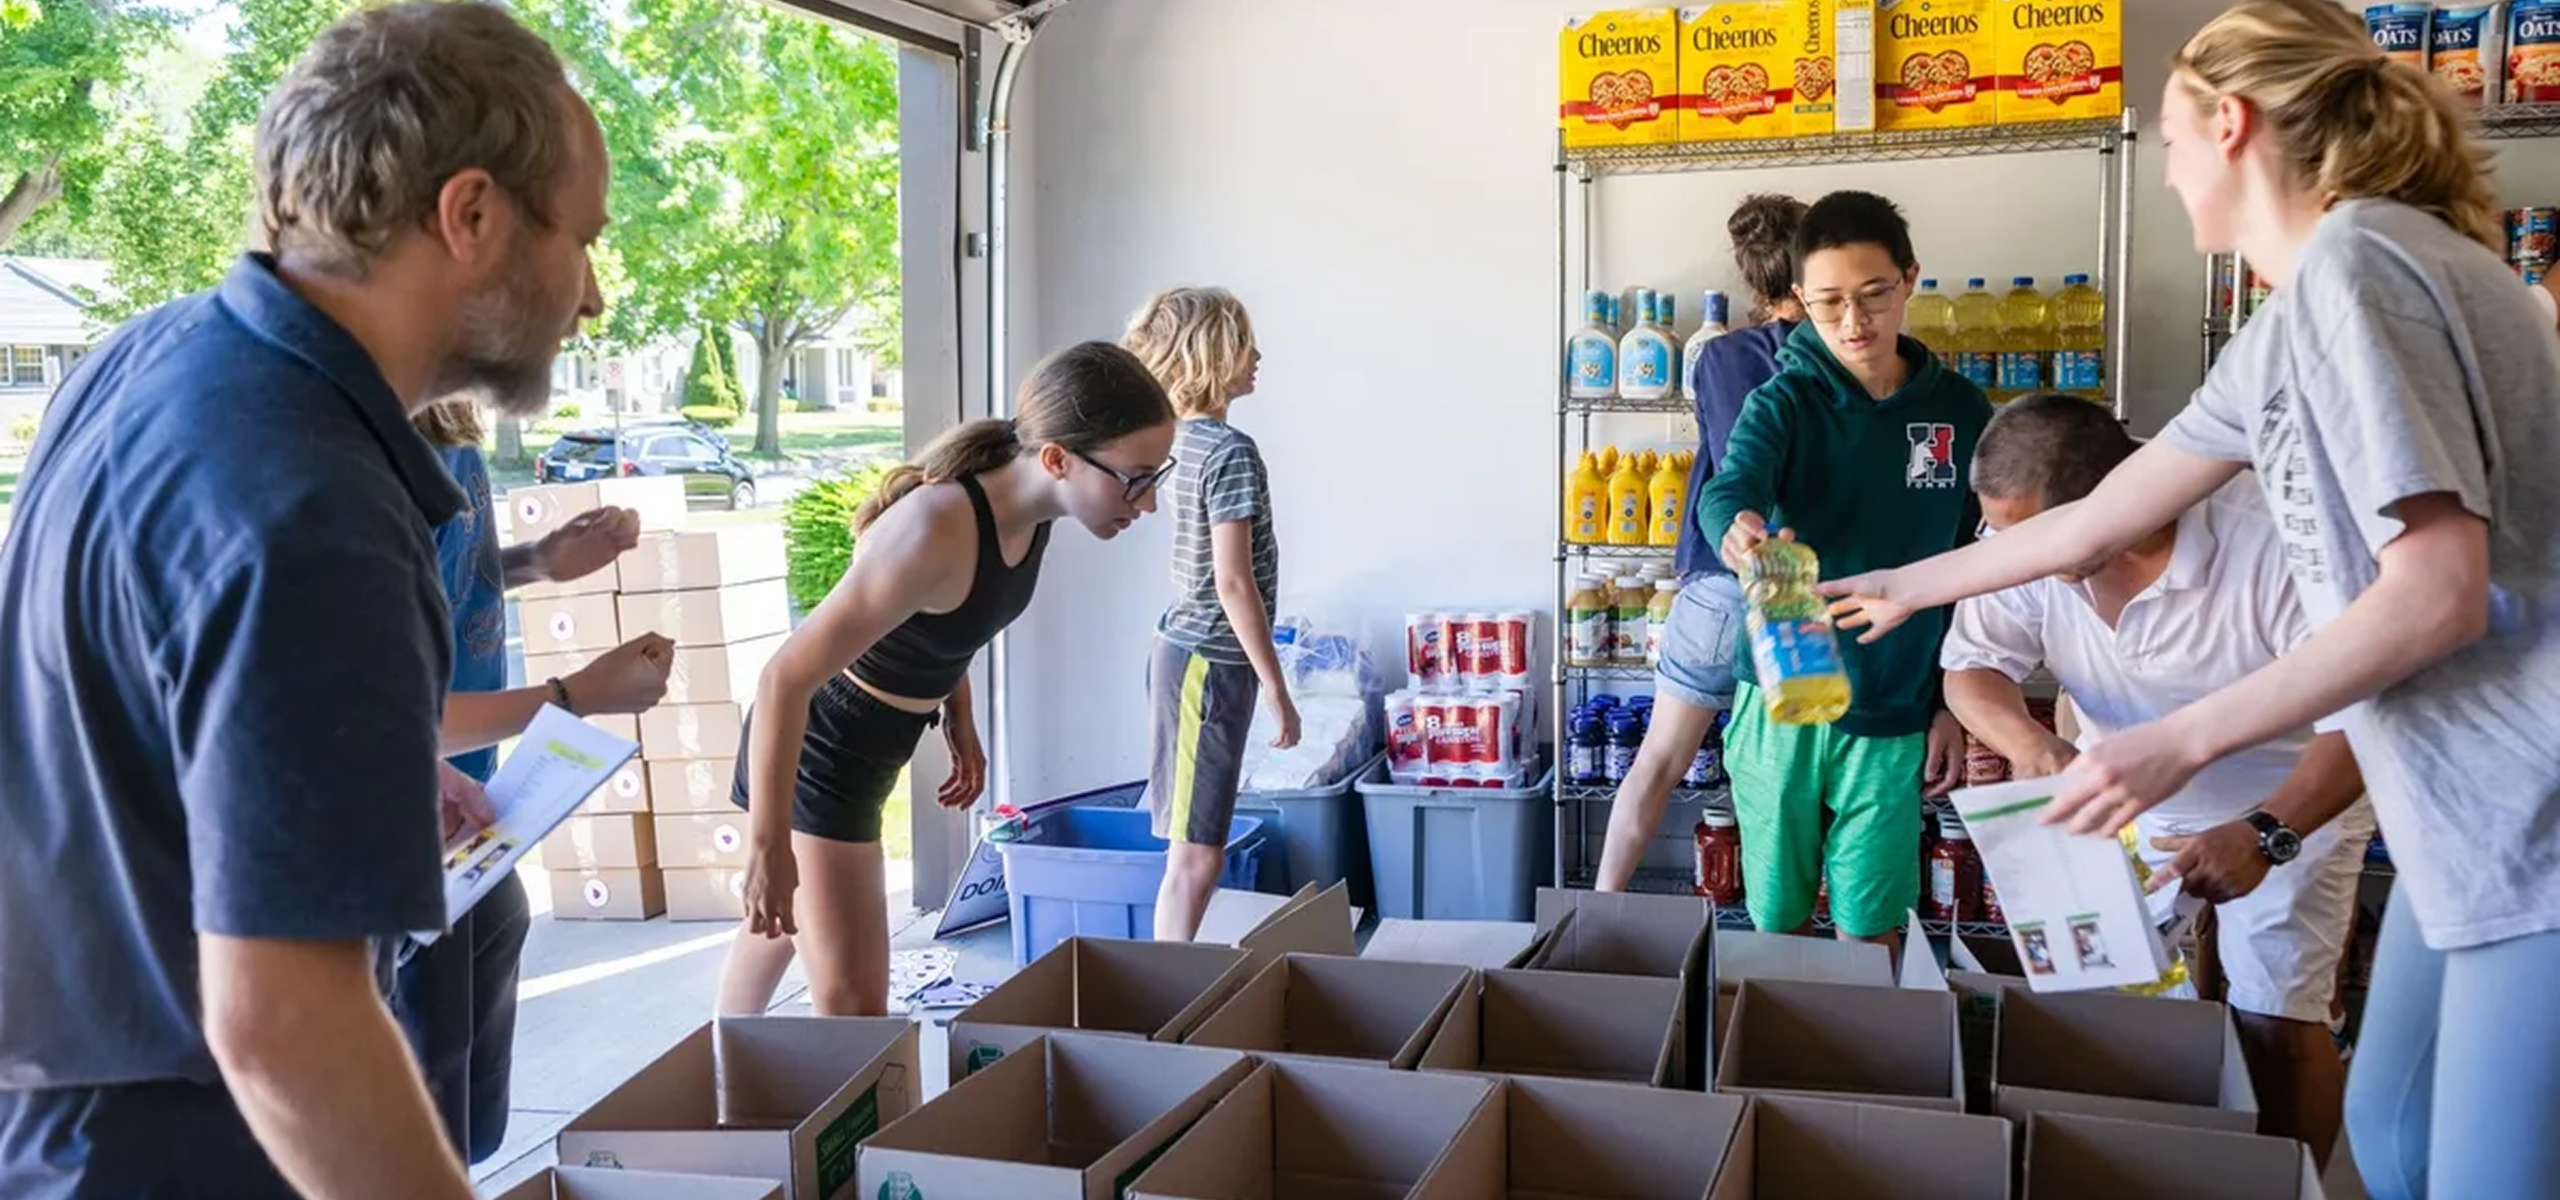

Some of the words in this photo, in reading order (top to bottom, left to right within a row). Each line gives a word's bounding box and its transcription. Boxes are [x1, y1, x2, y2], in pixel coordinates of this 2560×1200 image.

[1890, 13, 1979, 39] Cheerios
[2013, 3, 2105, 30] Cheerios
[1579, 33, 1661, 58] Cheerios
[1693, 26, 1778, 51] Cheerios
[2373, 29, 2417, 46] OATS
[1427, 714, 1441, 729] 8
